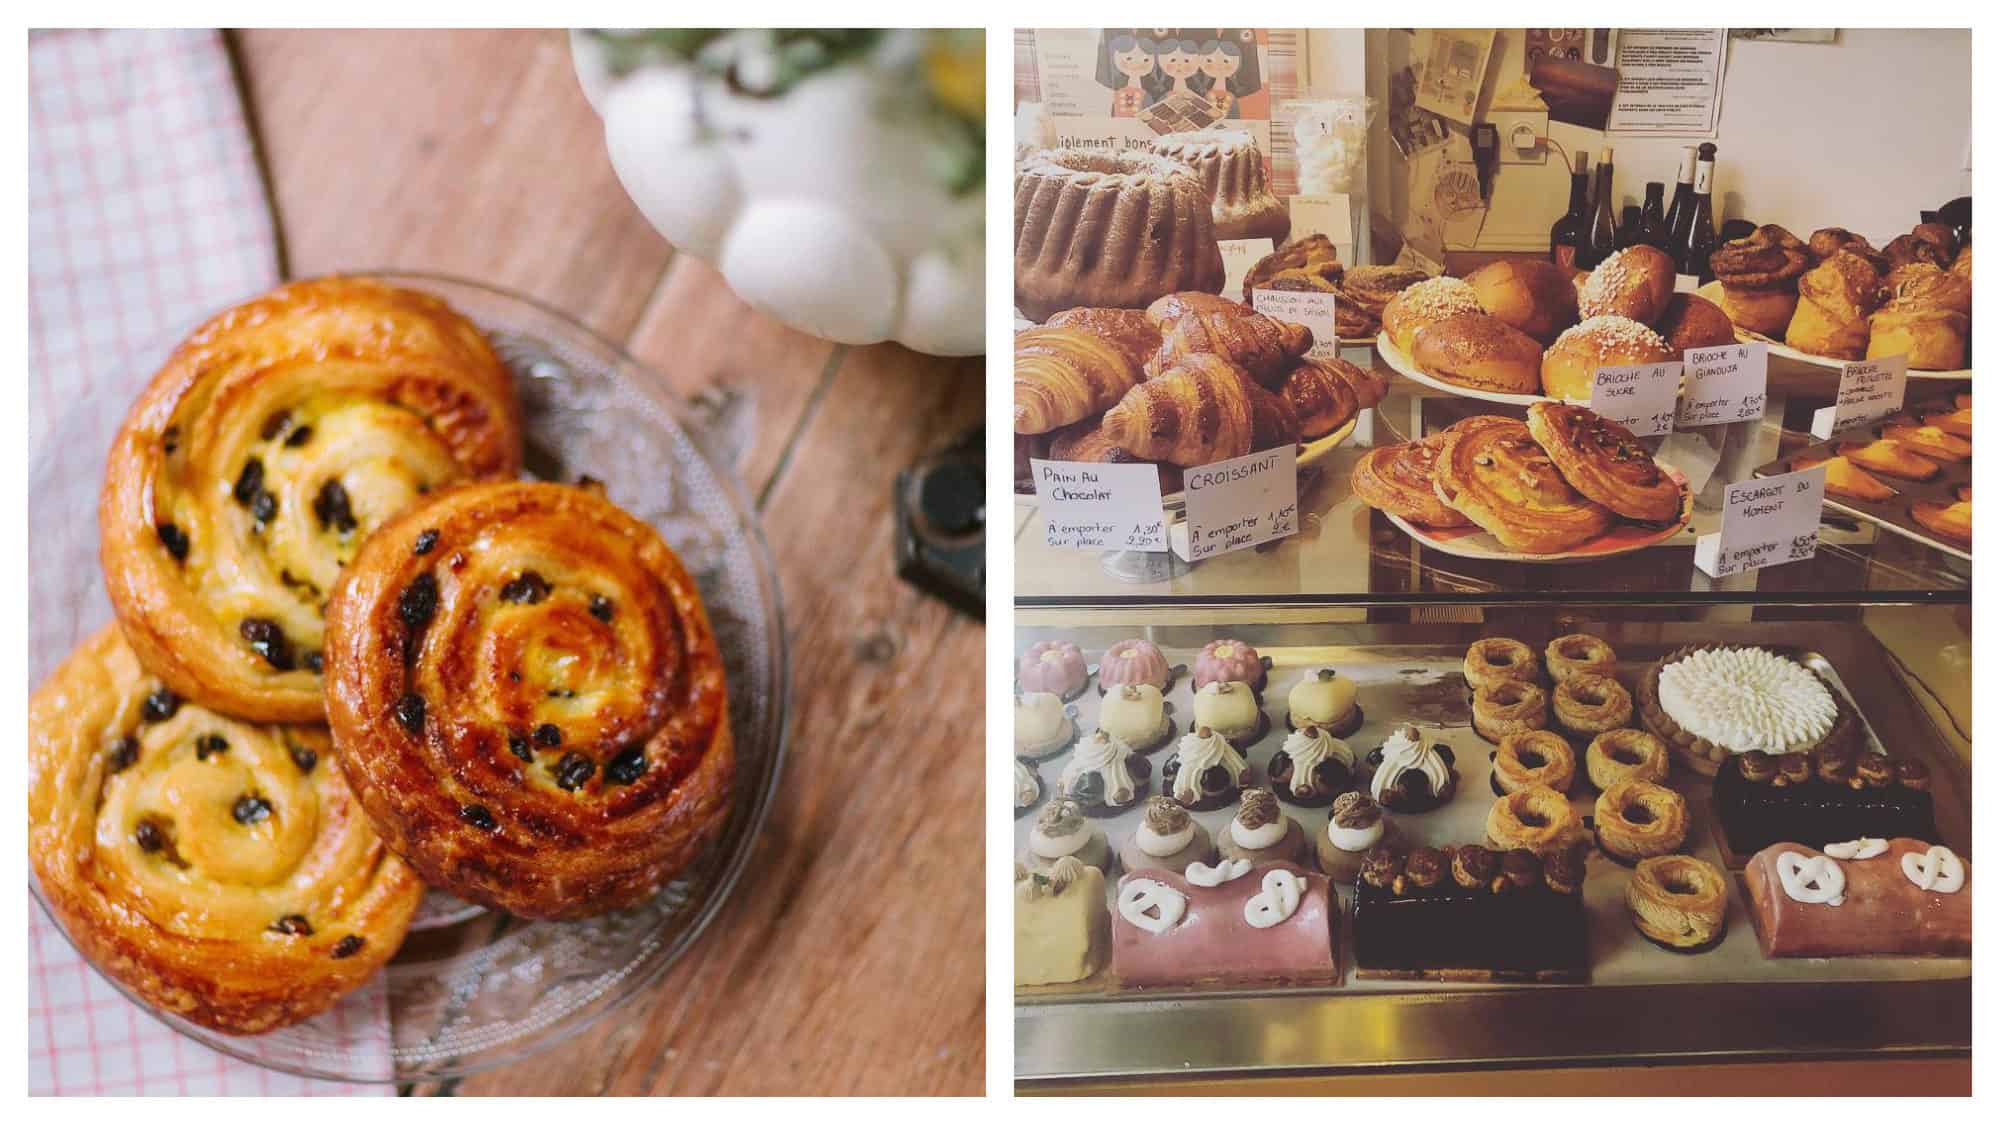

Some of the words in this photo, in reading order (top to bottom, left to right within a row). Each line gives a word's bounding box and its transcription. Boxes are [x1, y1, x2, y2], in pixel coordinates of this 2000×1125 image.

[1056, 136, 1118, 150] iplement
[1738, 348, 1749, 359] AU
[1653, 367, 1666, 378] AU
[1190, 455, 1279, 491] CROISSANT
[1730, 485, 1785, 505] ESCARGOT
[1743, 501, 1784, 518] MOMENT
[1207, 517, 1258, 539] emporter
[1192, 543, 1217, 558] Sur
[1225, 533, 1252, 550] place
[1733, 542, 1779, 561] emporter
